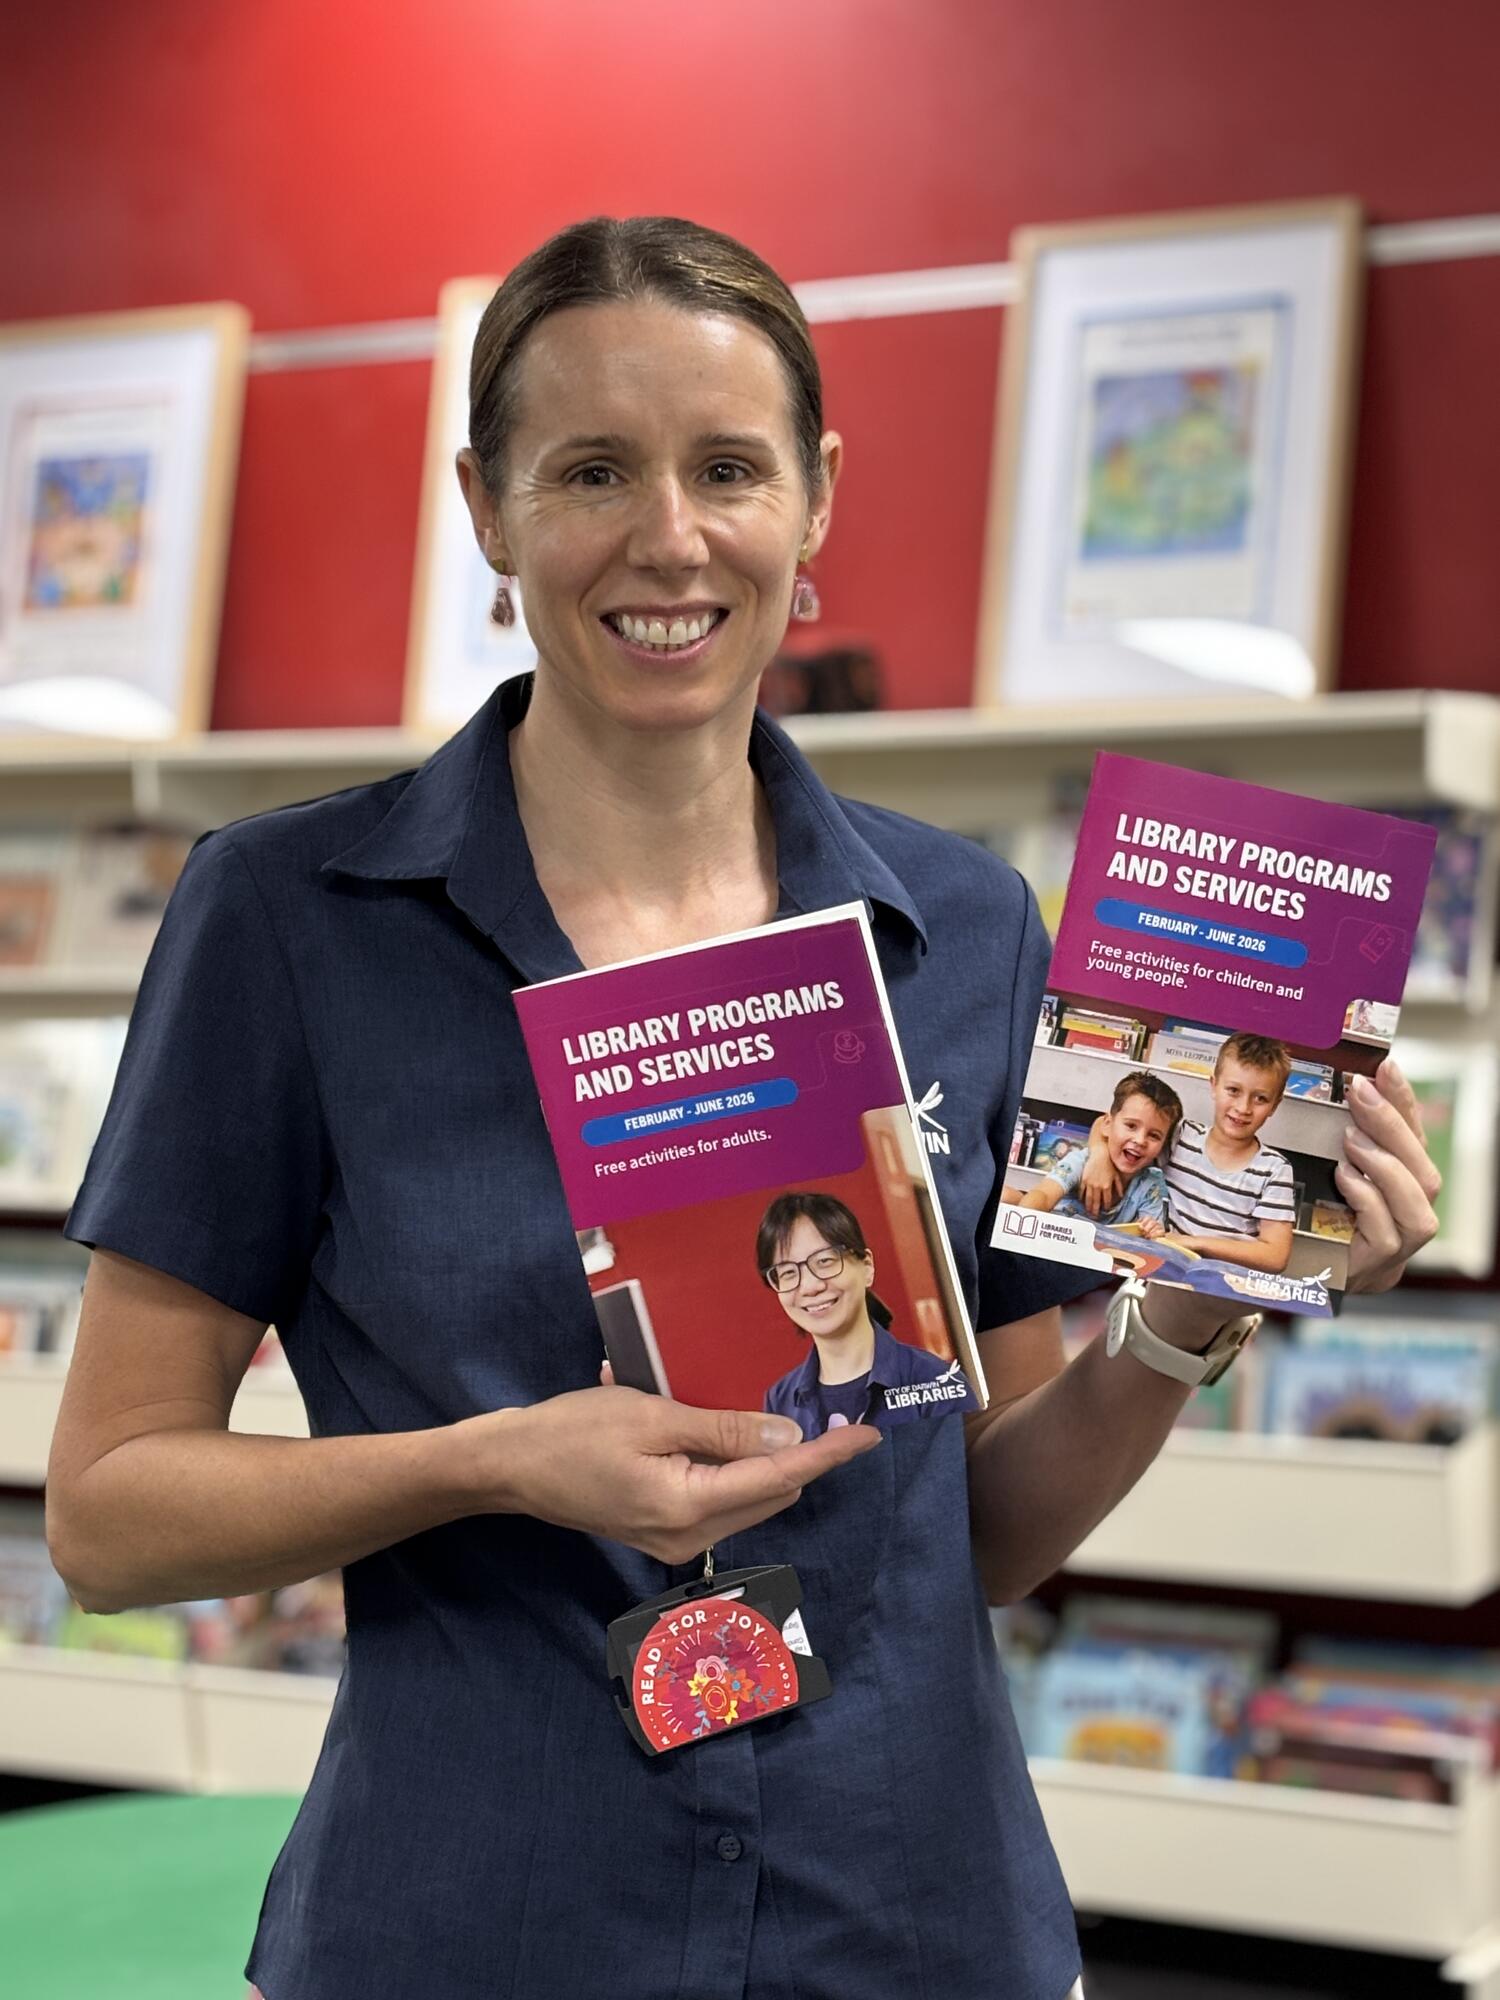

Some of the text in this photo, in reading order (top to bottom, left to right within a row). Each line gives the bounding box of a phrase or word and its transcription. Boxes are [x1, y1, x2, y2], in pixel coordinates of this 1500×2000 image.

[1116, 813, 1392, 901] LIBRARY PROGRAMS
[1107, 851, 1306, 920] AND SERVICES
[1138, 912, 1198, 936] FEBRUARY
[1205, 928, 1237, 945] JUNE
[1237, 935, 1266, 952] 2026
[1086, 956, 1188, 989] young people.
[1090, 940, 1303, 1000] Free activities for children and
[562, 981, 844, 1065] LIBRARY PROGRAMS
[575, 1033, 775, 1102] AND SERVICES
[624, 1106, 684, 1131] FEBRUARY
[694, 1098, 724, 1116] JUNE
[725, 1091, 755, 1108] 2026
[594, 1128, 772, 1177] Free activities for adults.
[1040, 1230, 1053, 1239] FOR
[1041, 1222, 1073, 1235] LIBRARIES
[1245, 1277, 1328, 1306] LIBRARIES
[1248, 1269, 1265, 1278] CITY
[884, 1387, 900, 1397] CITY
[901, 1385, 911, 1394] OF
[885, 1384, 967, 1410] LIBRARIES
[641, 1610, 766, 1705] READ FOR JOY
